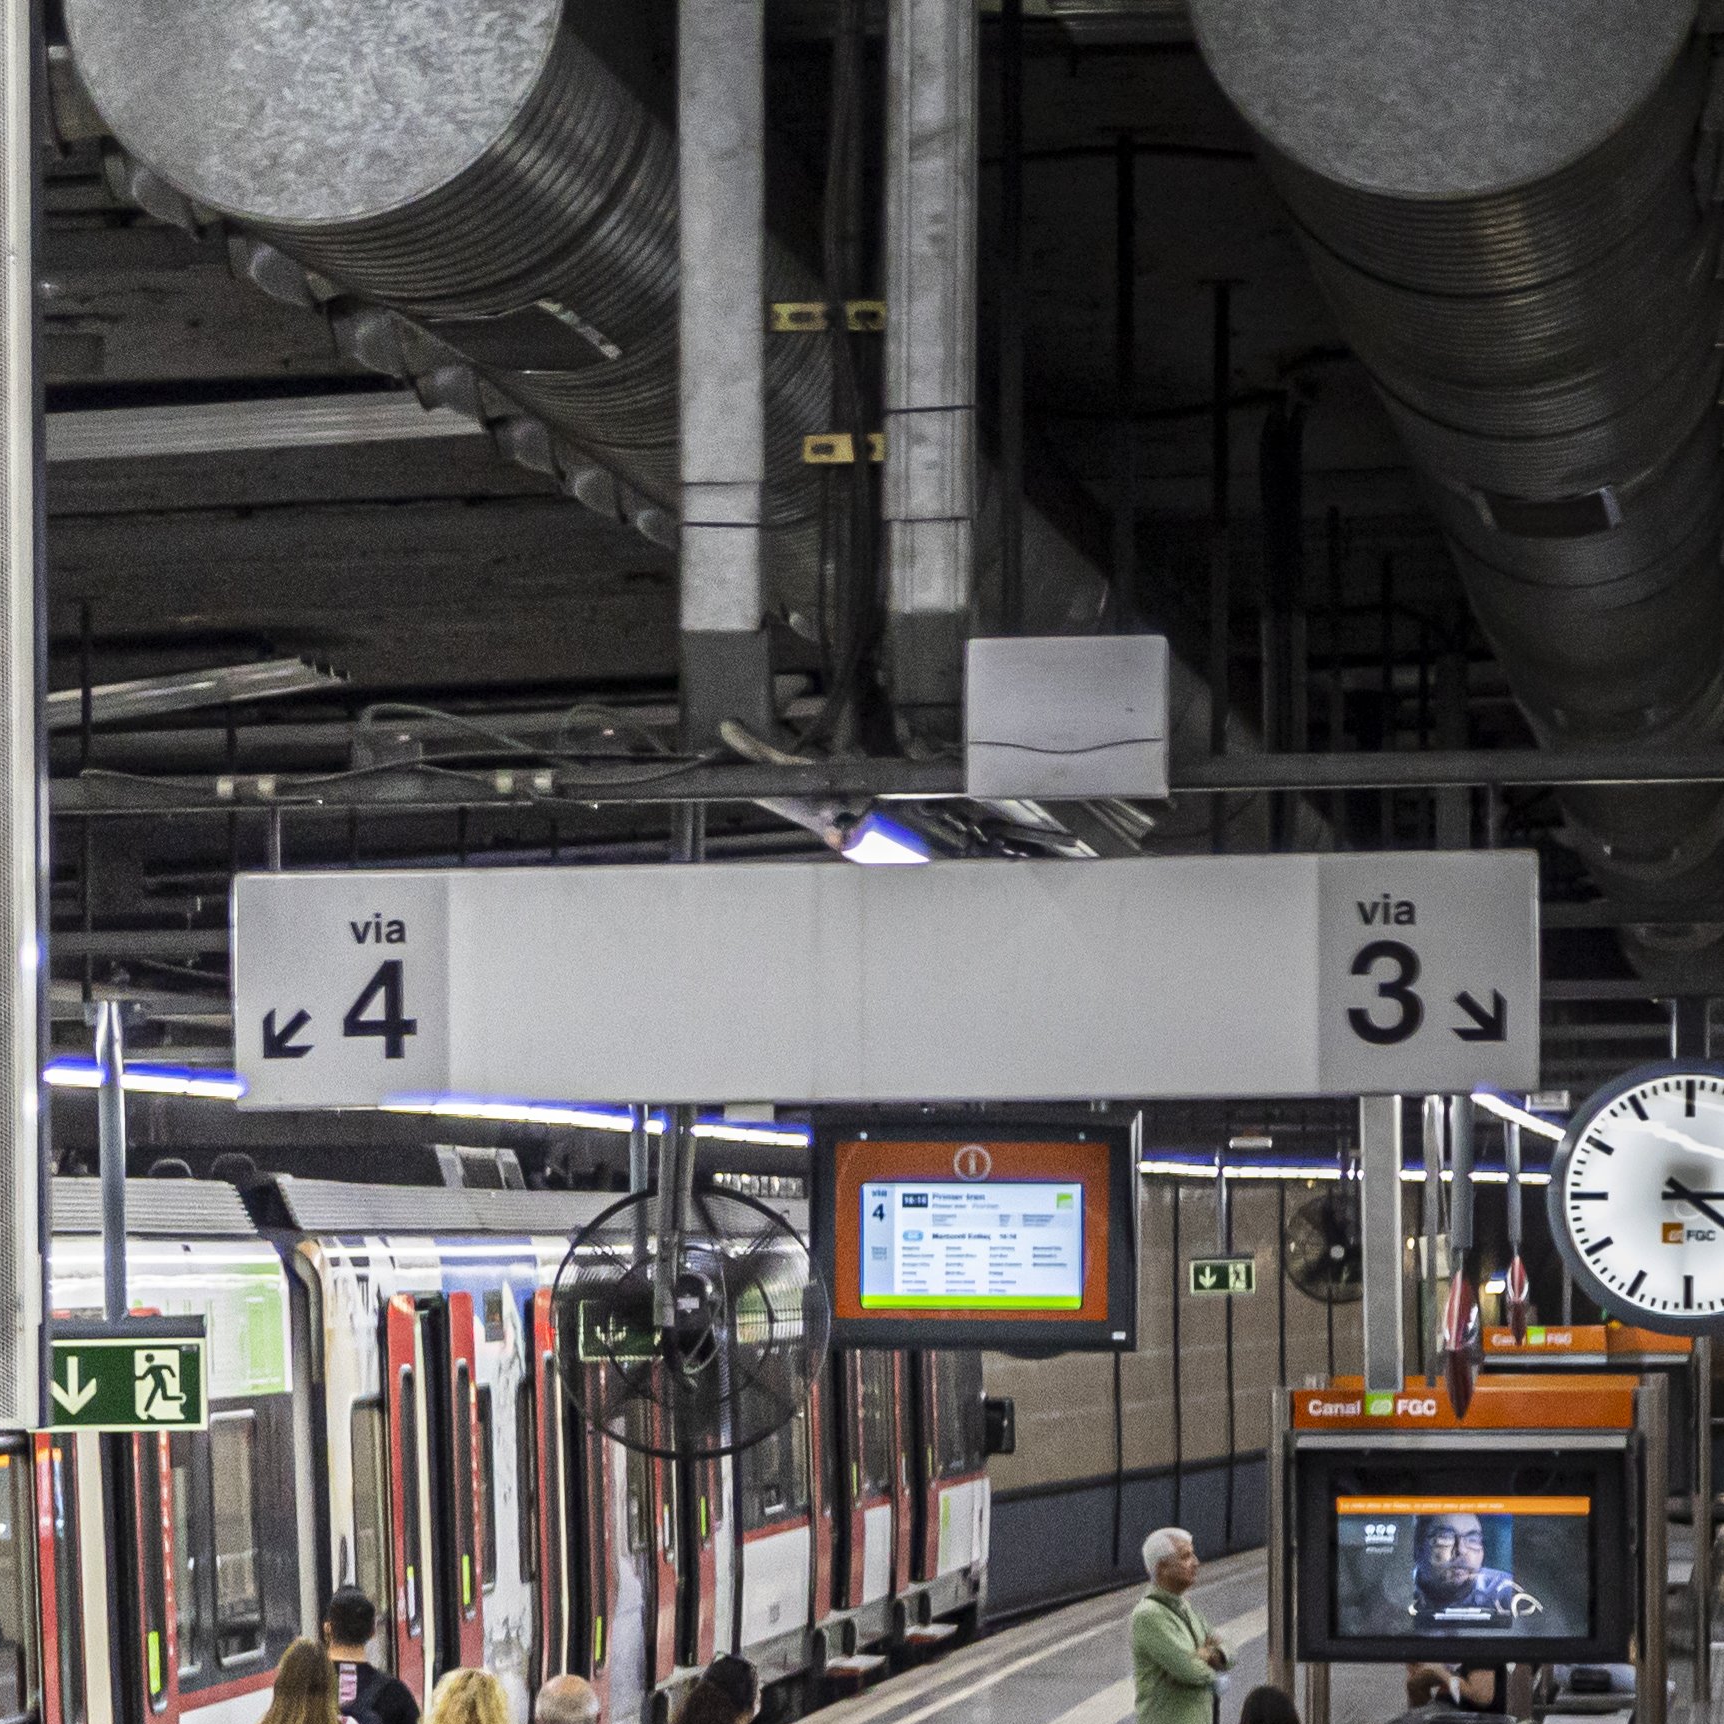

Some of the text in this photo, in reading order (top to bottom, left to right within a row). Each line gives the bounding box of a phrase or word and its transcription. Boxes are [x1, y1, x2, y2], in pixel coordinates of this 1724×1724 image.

[1357, 893, 1416, 927] via
[351, 914, 407, 946] via
[343, 960, 416, 1058] 4
[1348, 942, 1423, 1045] 3
[872, 1204, 885, 1221] 4
[1687, 1230, 1716, 1241] FGC
[1309, 1399, 1437, 1417] Canal FGC
